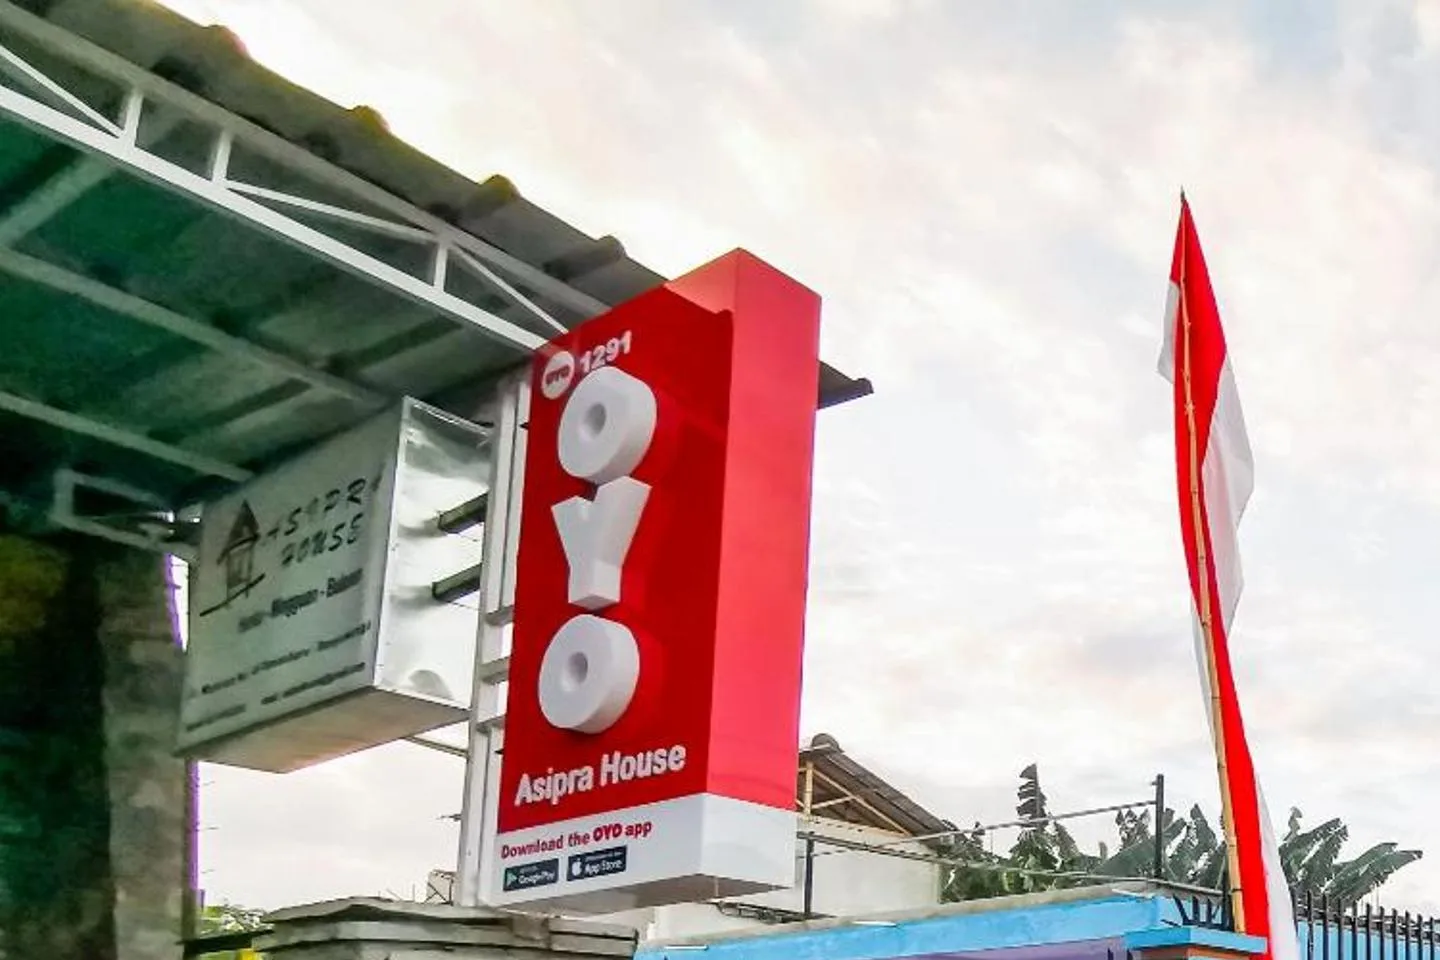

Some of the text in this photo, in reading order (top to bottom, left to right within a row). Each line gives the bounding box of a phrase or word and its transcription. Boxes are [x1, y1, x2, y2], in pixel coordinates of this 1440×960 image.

[580, 330, 632, 373] 1291
[538, 366, 658, 735] OYO
[514, 744, 687, 806] Asipra House
[501, 835, 564, 859] Download
[568, 831, 591, 848] the
[593, 823, 623, 842] OYO
[625, 821, 653, 839] app
